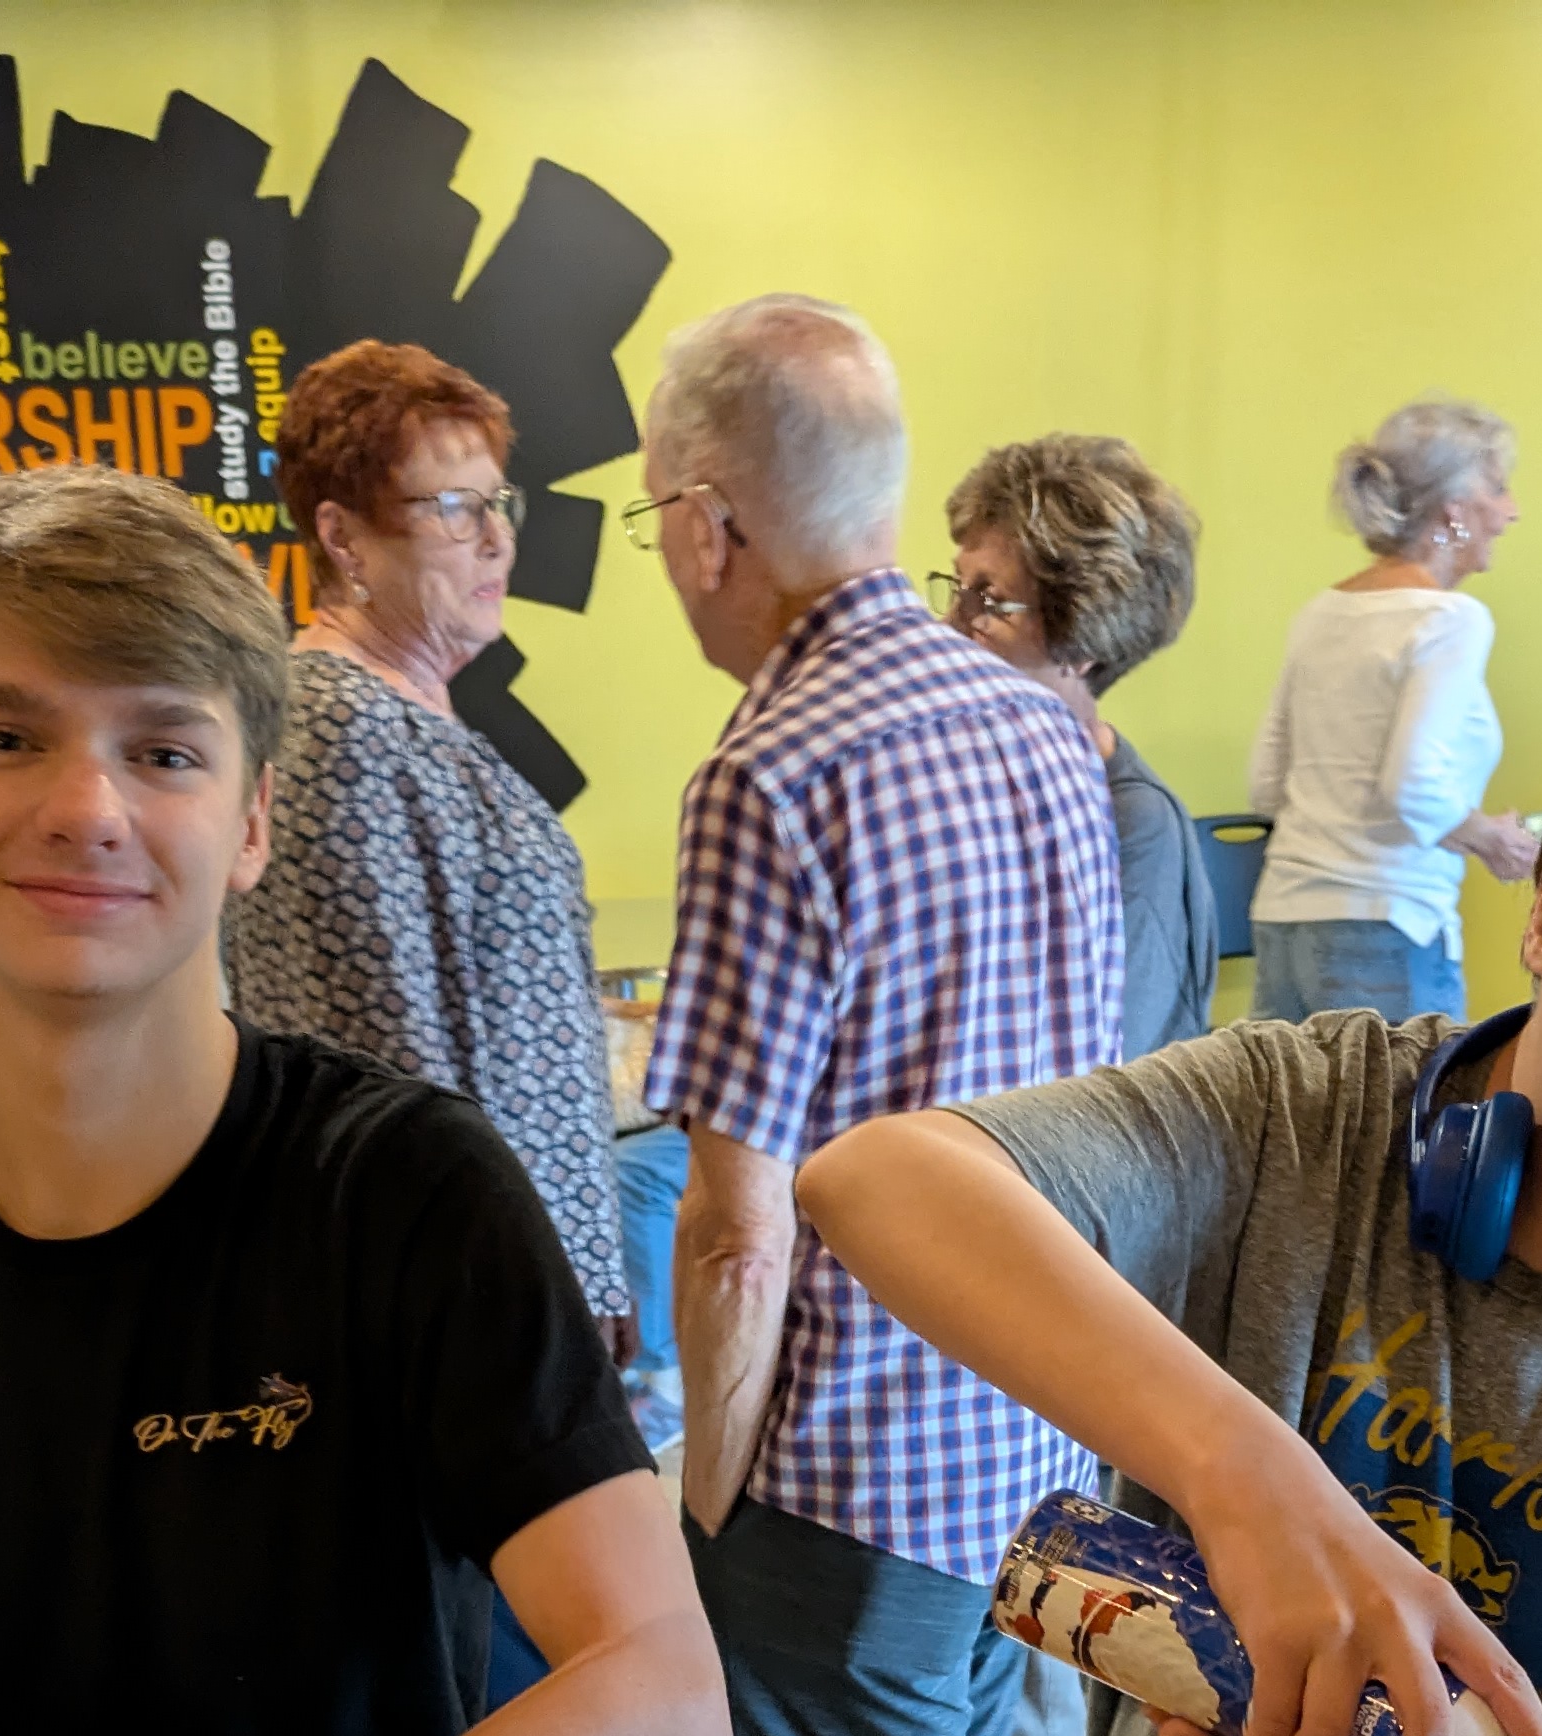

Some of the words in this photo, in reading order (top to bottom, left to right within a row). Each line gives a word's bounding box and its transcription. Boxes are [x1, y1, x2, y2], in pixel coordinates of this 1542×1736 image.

[201, 239, 237, 331] Bible
[19, 329, 209, 381] believe
[211, 339, 242, 396] the
[213, 402, 250, 499] study
[179, 1410, 237, 1453] The
